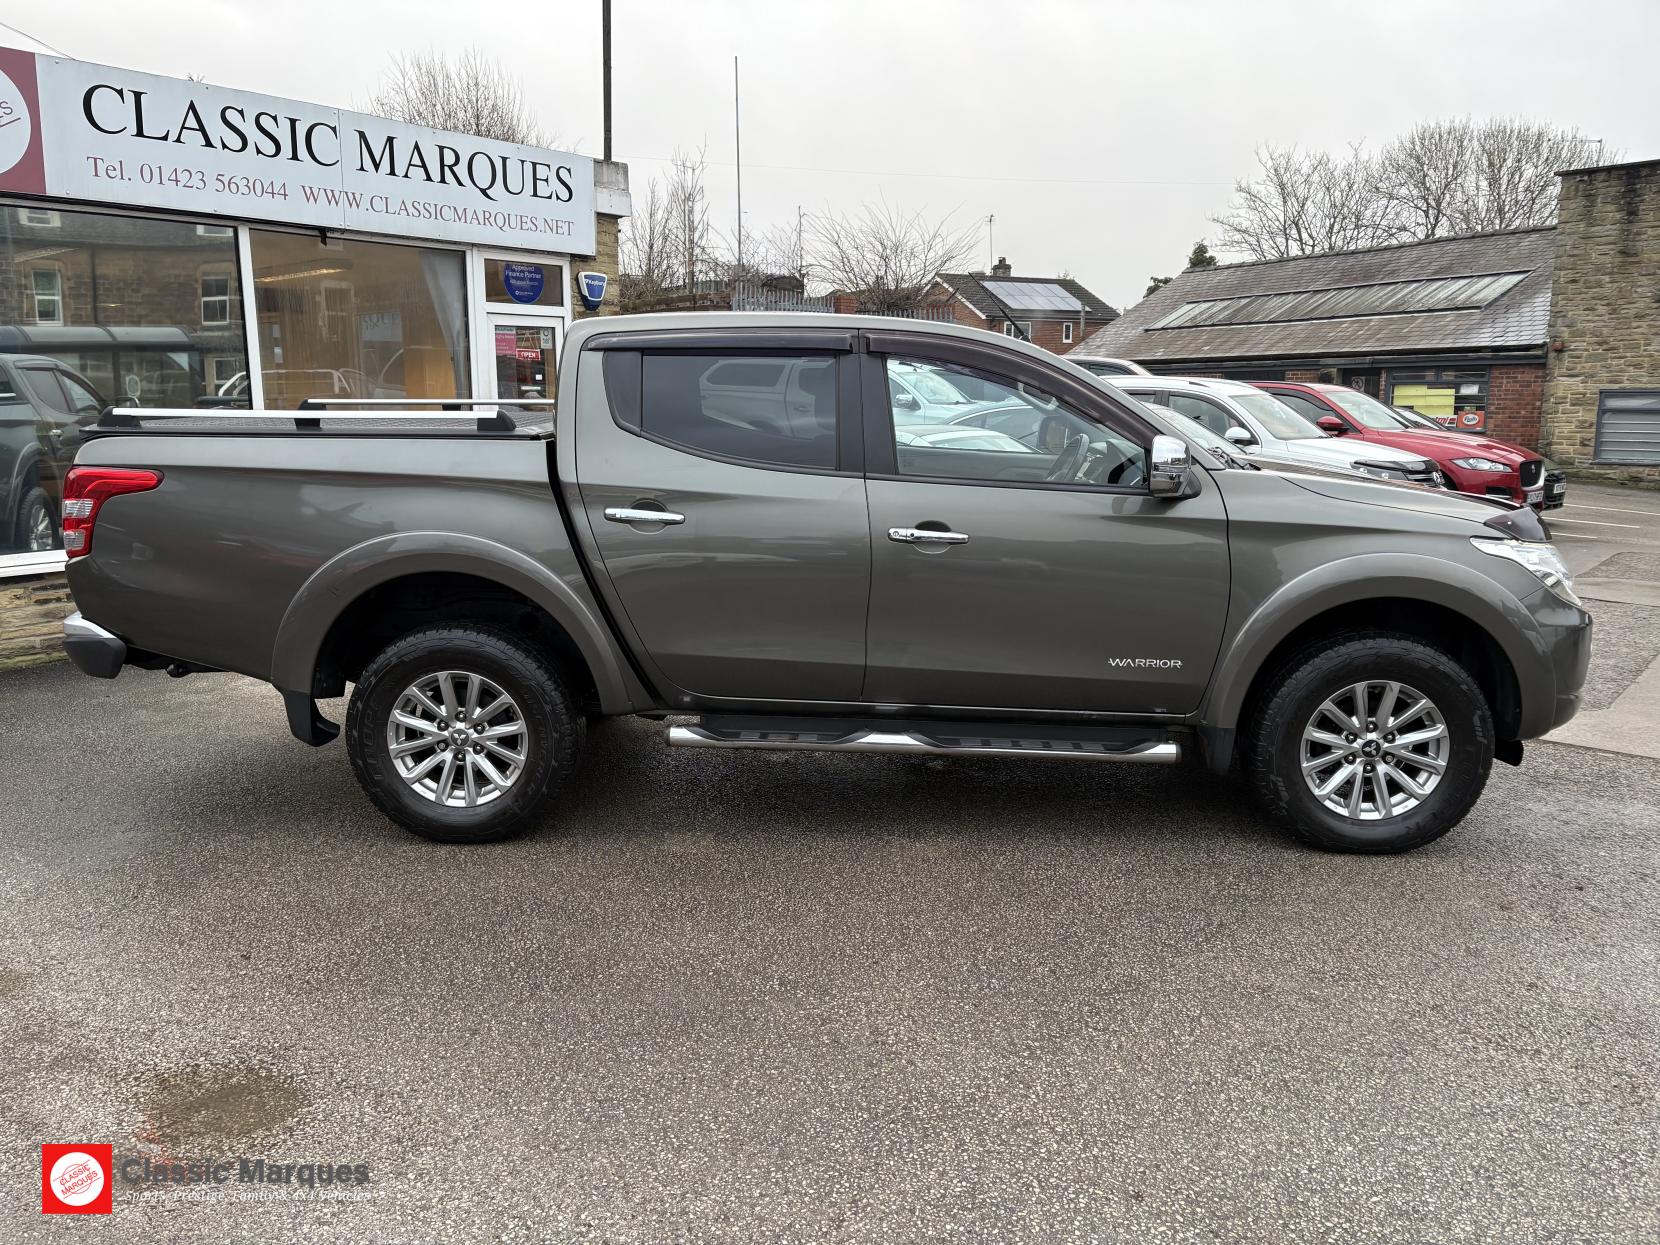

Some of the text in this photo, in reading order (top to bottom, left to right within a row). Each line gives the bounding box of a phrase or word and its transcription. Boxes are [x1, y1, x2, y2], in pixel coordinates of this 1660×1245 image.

[82, 83, 574, 203] CLASSIC MARQUES
[86, 156, 575, 237] Tel. 01423 563044 WWW.CLASSICMARQUES.NET
[1108, 658, 1183, 669] WARRIOR
